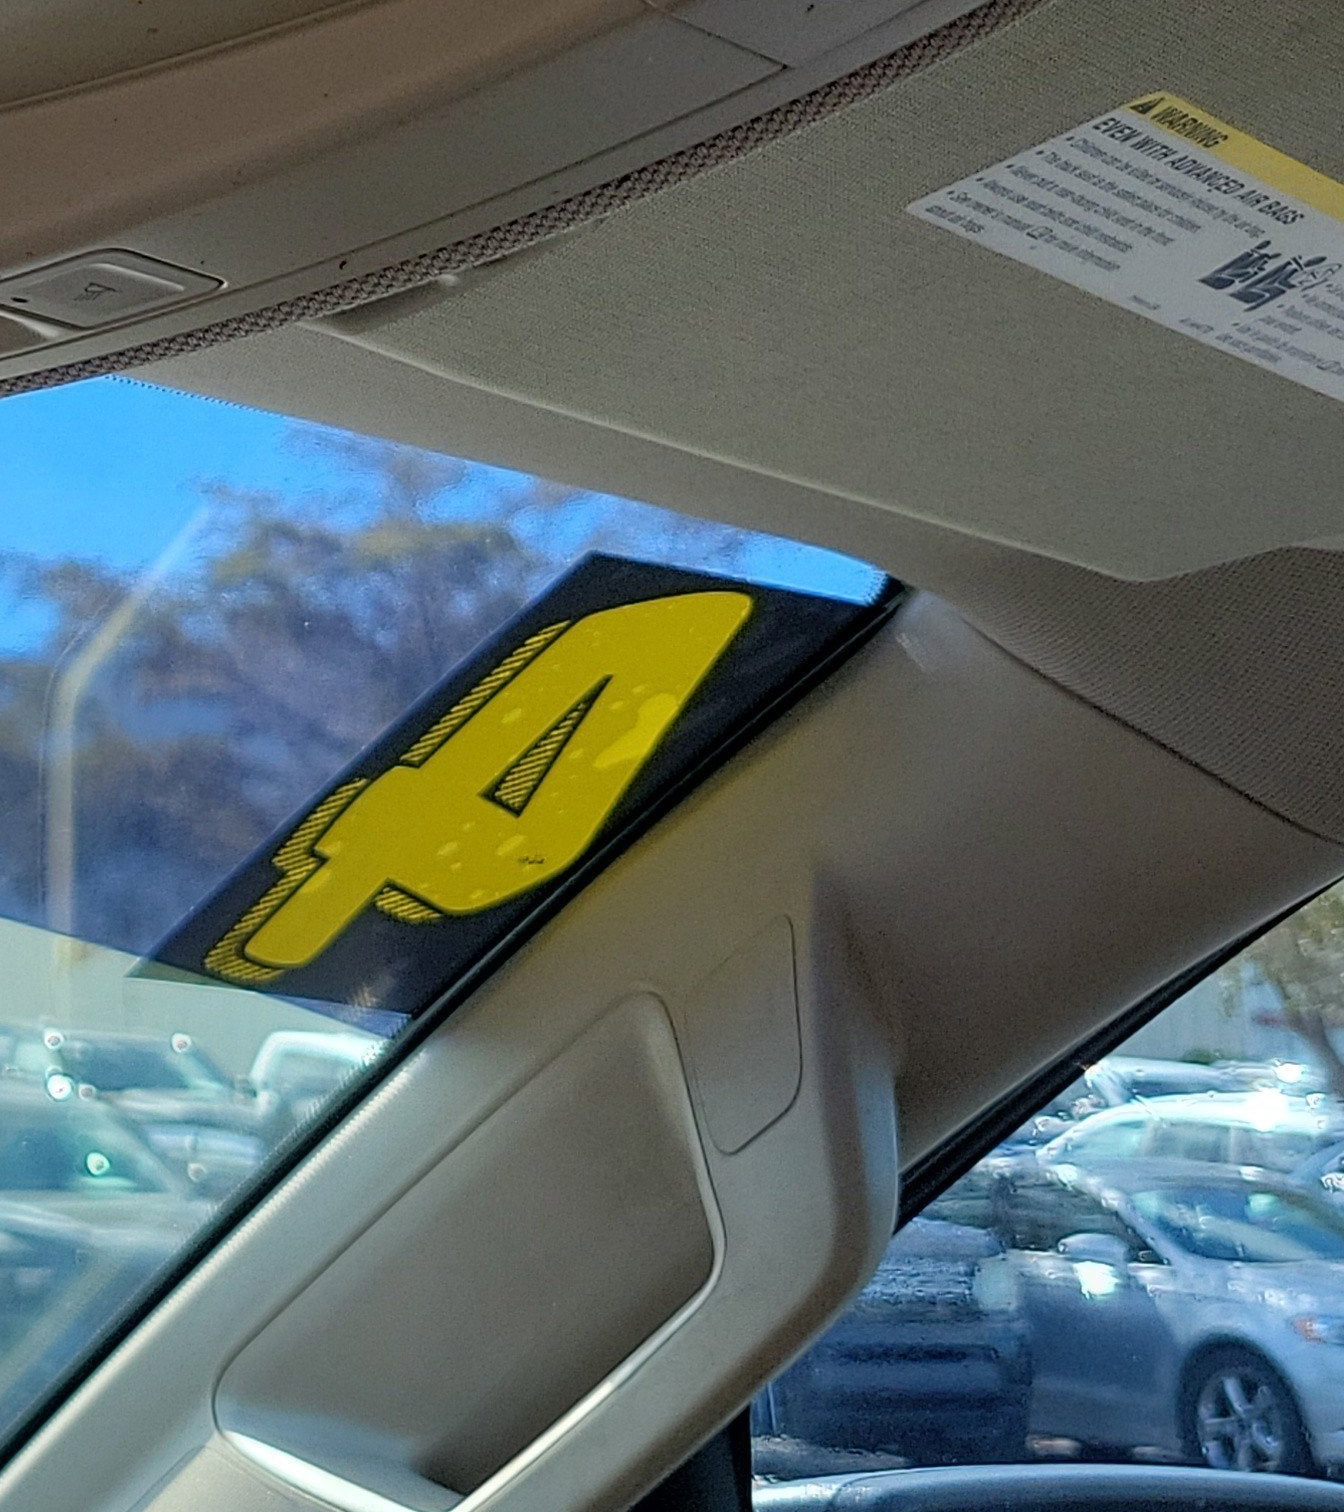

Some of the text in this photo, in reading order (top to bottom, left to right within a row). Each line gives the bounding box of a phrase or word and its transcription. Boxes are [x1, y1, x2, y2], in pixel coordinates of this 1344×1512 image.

[1149, 105, 1229, 149] WARNING
[1091, 116, 1305, 226] EVEN WITH ADVANCED AIR BAGS
